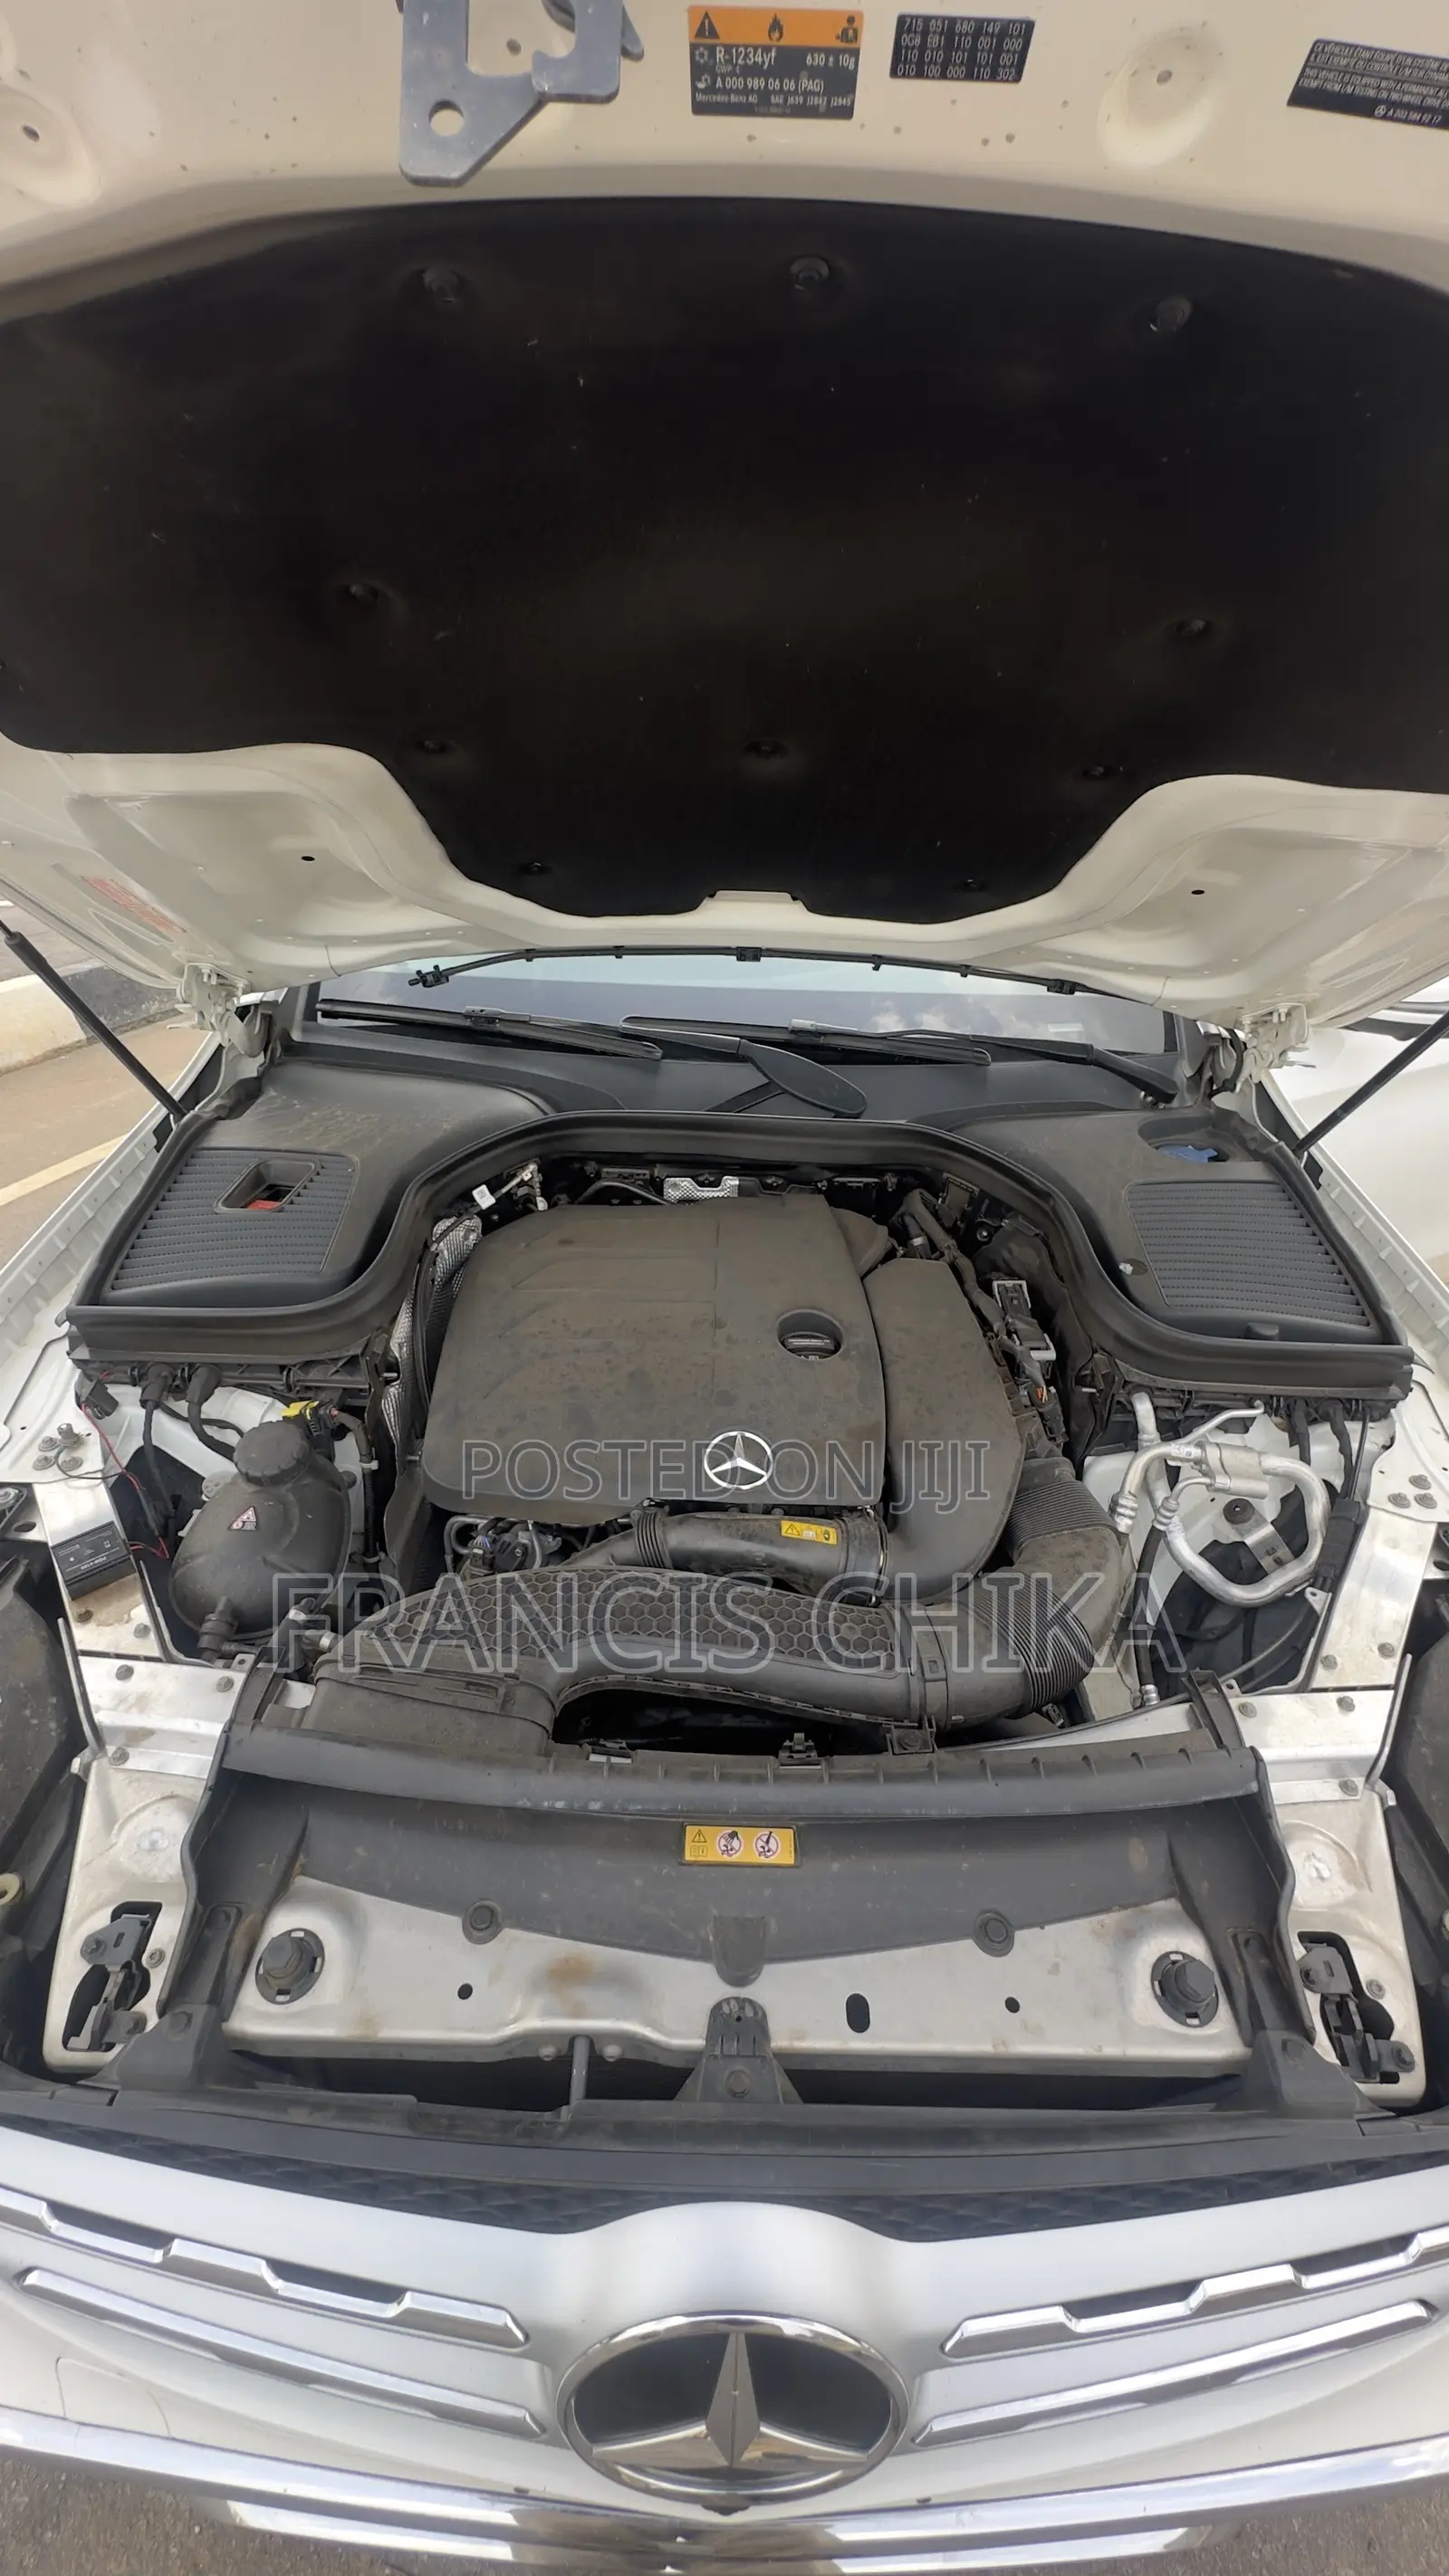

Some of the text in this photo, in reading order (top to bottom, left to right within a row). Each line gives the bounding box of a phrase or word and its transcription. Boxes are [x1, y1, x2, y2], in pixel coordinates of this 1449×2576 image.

[904, 18, 923, 32] 715
[929, 19, 948, 33] 051
[955, 20, 974, 34] 680
[1009, 23, 1025, 34] 101
[955, 35, 972, 48] 110
[978, 36, 996, 50] 001
[1003, 38, 1022, 51] 000
[716, 47, 776, 70] R-1234yf
[806, 53, 825, 66] 630
[839, 53, 856, 70] 10g
[901, 49, 1018, 65] 110 010 101 101 001
[897, 64, 1015, 81] 010 100 000 110 302
[715, 76, 824, 94] A 000 989 06 06 (PAG)
[1387, 108, 1395, 117] A
